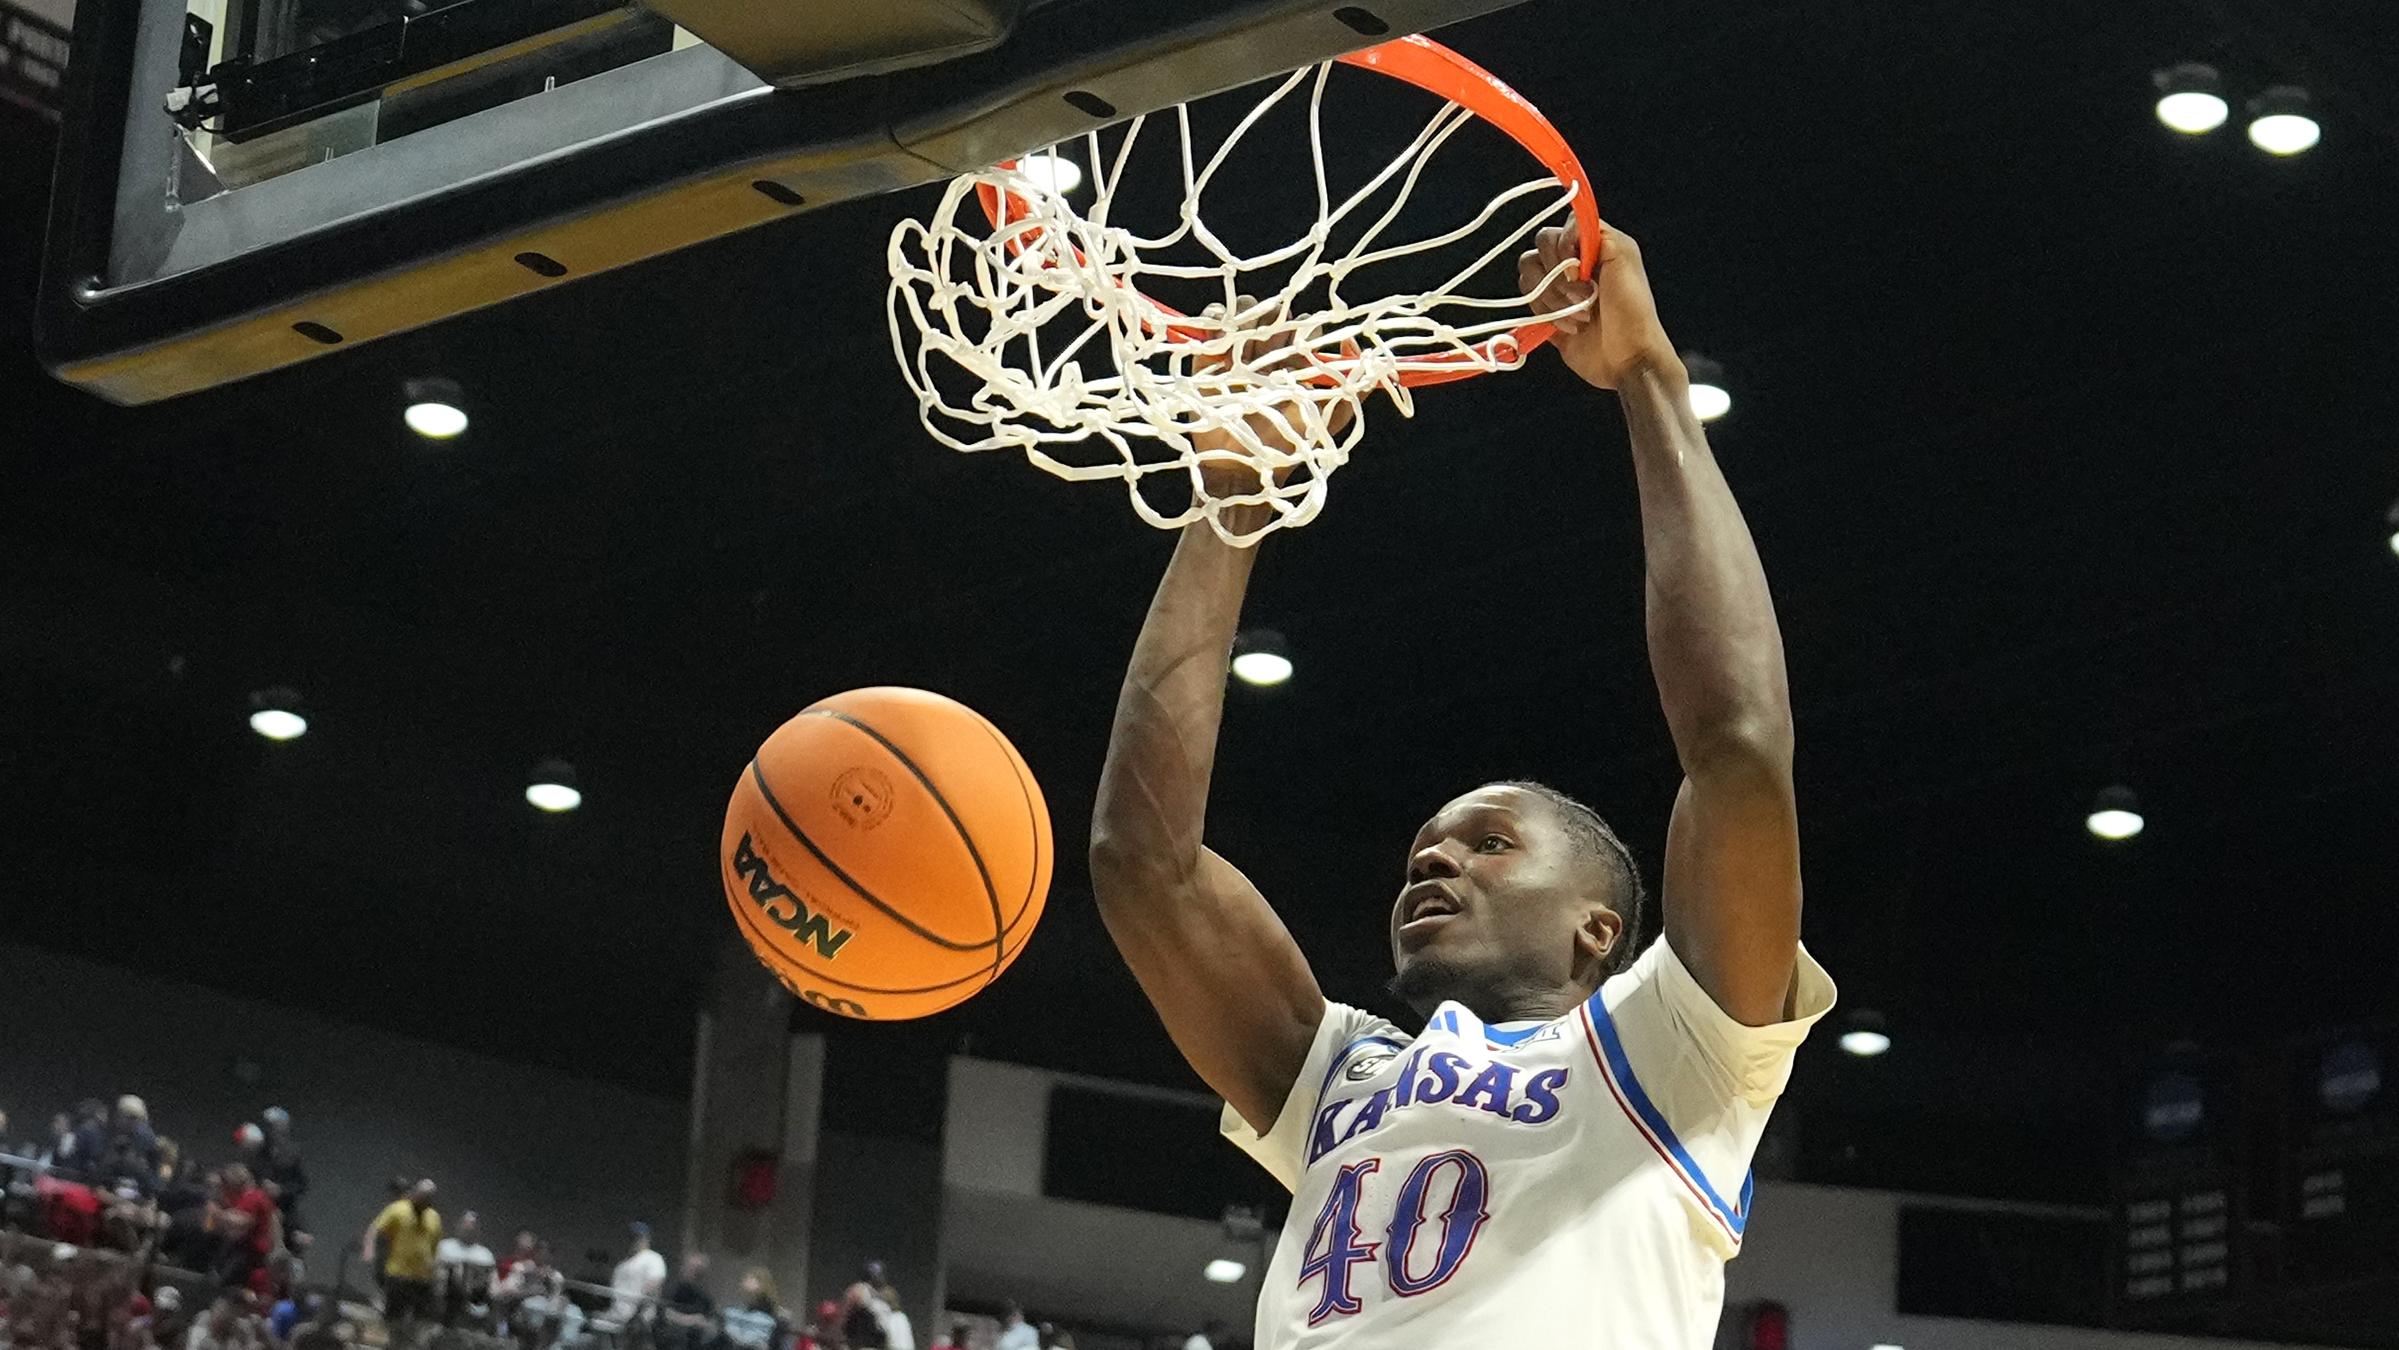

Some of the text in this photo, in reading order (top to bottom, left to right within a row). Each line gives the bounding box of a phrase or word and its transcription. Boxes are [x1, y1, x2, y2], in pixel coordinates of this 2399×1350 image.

[733, 830, 854, 961] NCAA
[1308, 1046, 1570, 1165] KANSAS
[1297, 1149, 1491, 1327] 40
